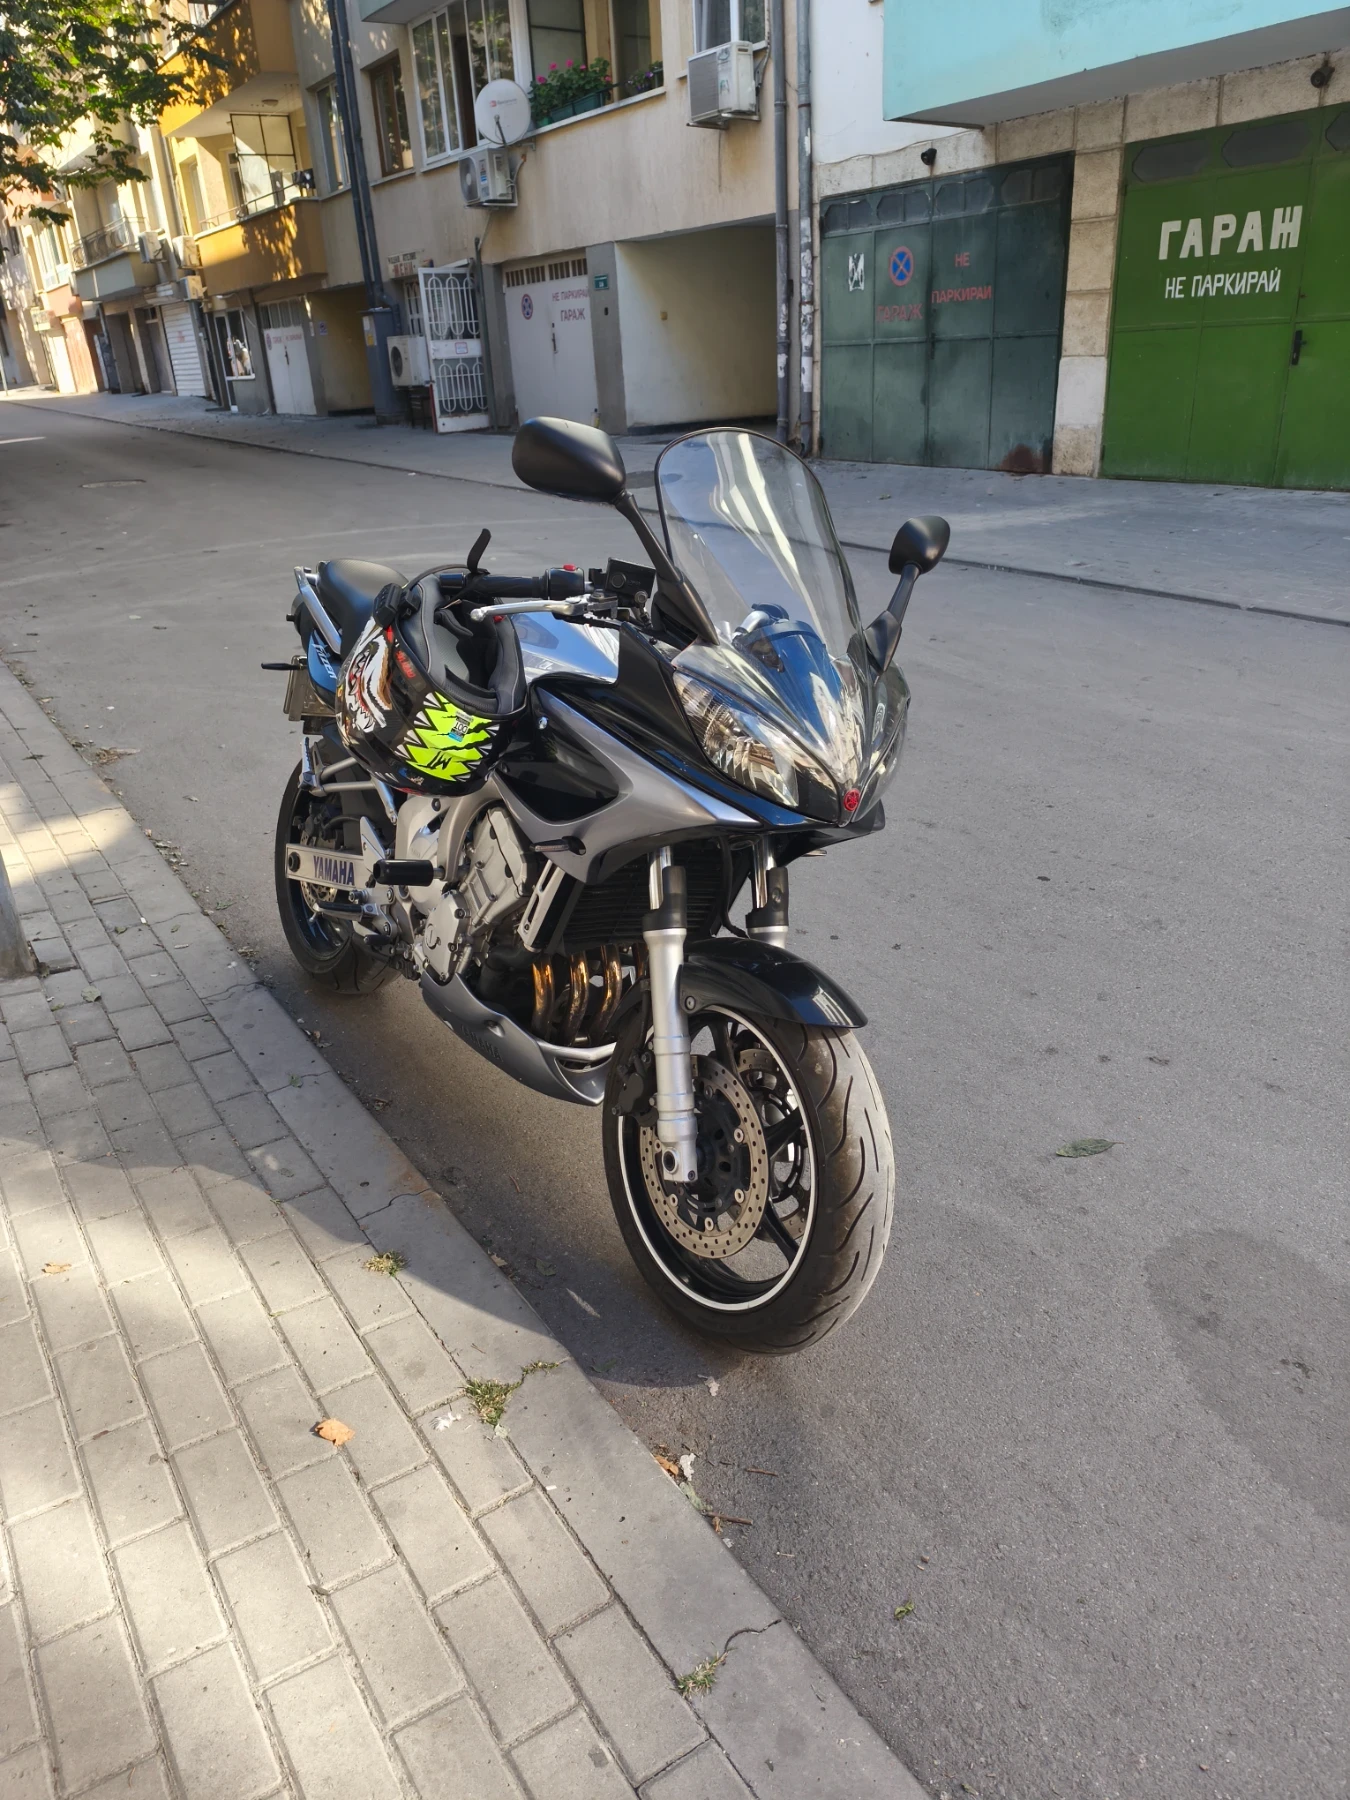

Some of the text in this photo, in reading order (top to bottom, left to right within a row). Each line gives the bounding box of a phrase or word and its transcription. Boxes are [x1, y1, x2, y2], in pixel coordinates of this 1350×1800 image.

[1158, 205, 1303, 260] ГАРАЖ
[955, 252, 970, 267] НЕ
[1165, 266, 1282, 299] НЕ ПАРКИРАЙ
[552, 292, 560, 302] НЕ
[561, 308, 586, 322] ГАРАЖ
[876, 303, 924, 323] ГАРАЖ
[313, 855, 355, 886] YAMAHA
